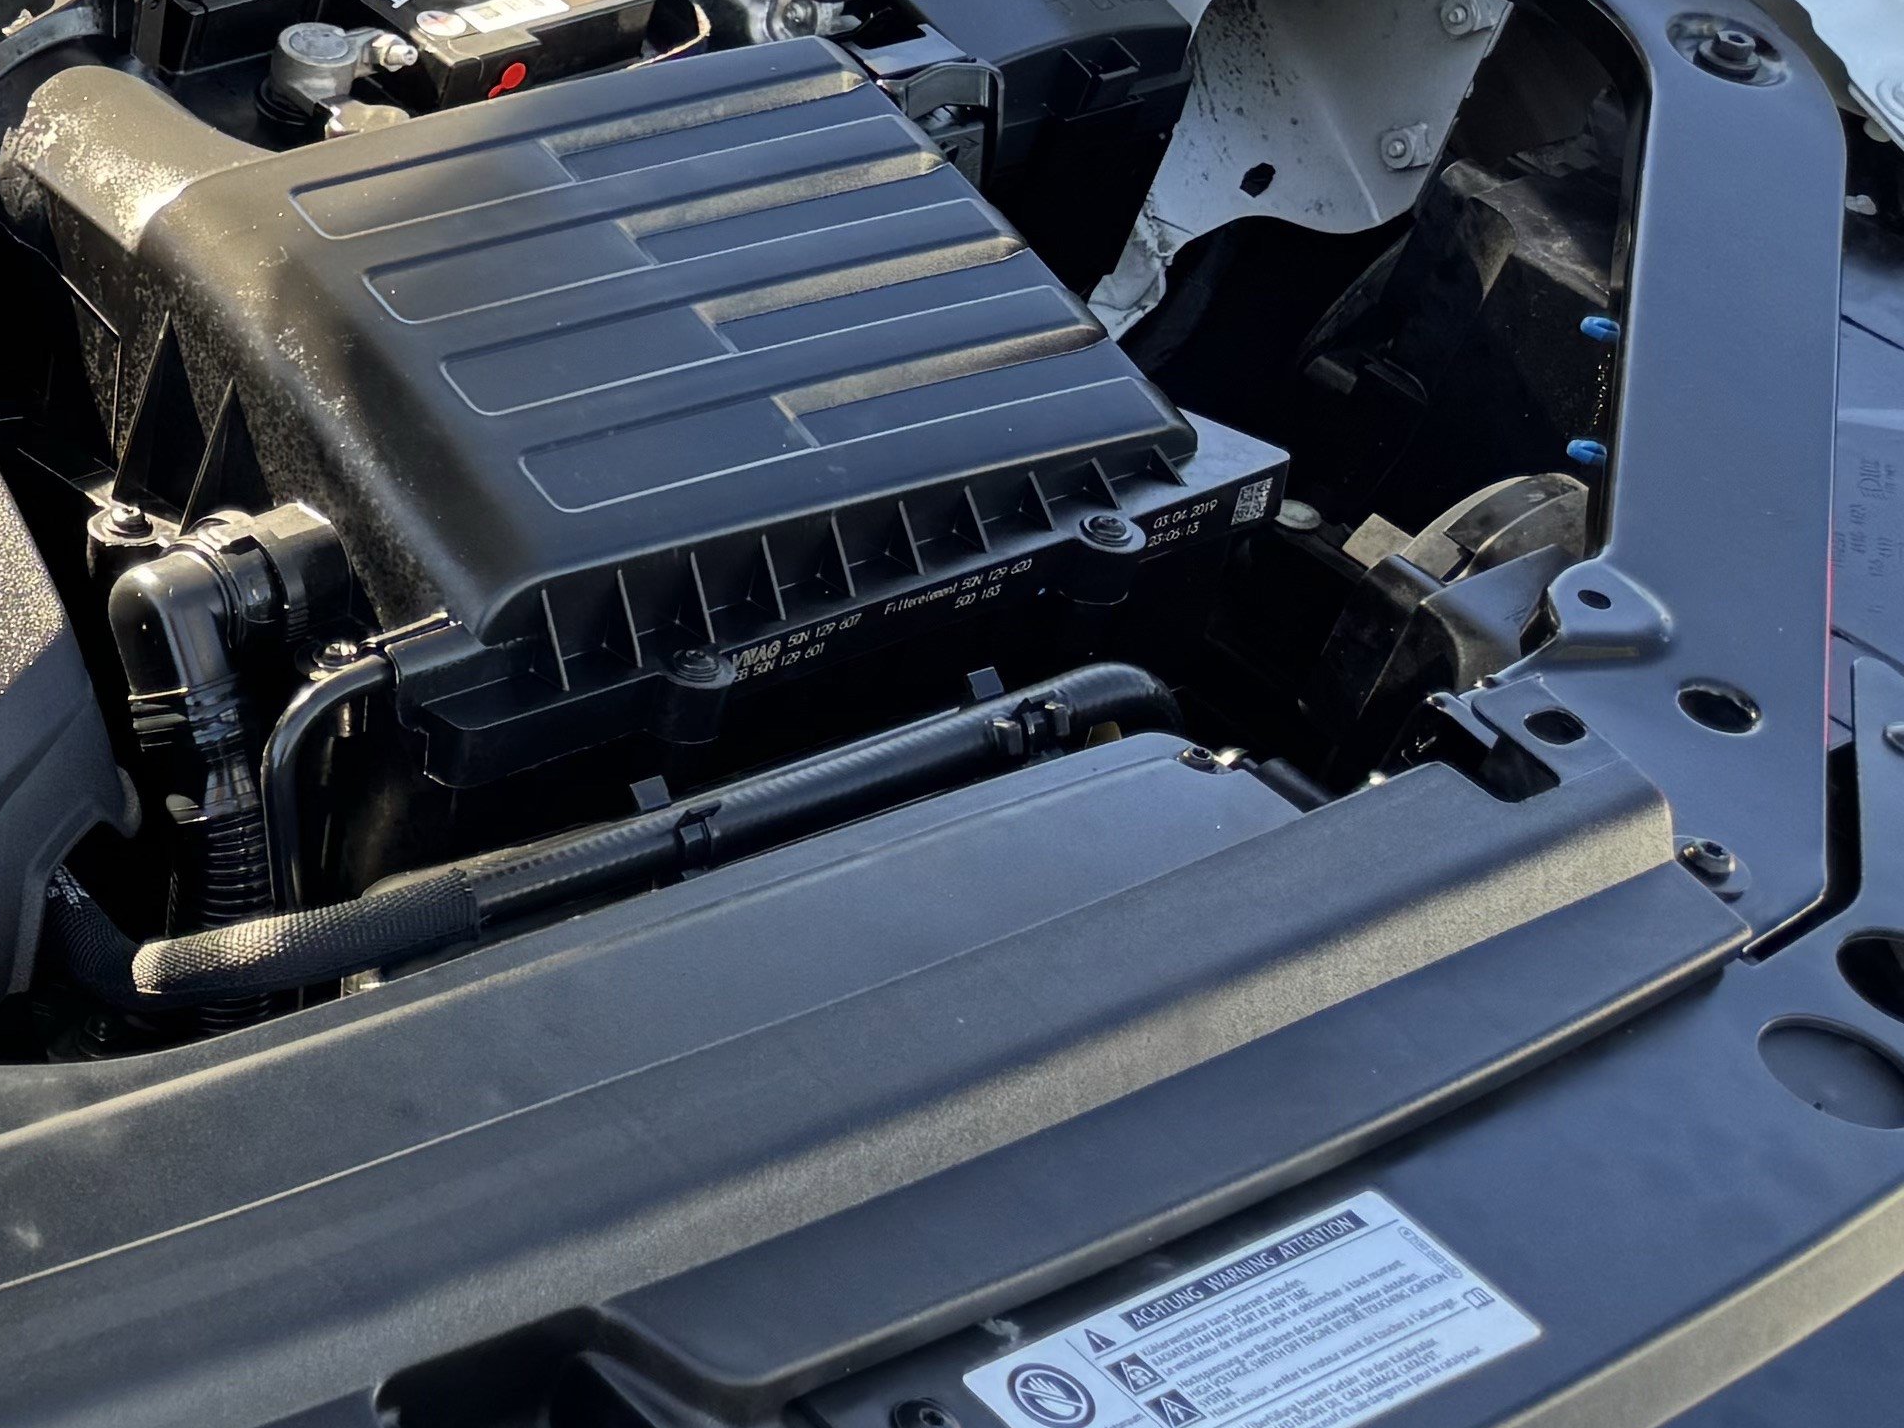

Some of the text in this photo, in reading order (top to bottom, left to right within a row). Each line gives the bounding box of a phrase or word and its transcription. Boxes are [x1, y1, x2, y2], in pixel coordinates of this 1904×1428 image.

[1131, 1285, 1204, 1326] ACHTUNG
[1203, 1252, 1277, 1291] WARNING
[1278, 1216, 1355, 1259] ATTENTION
[1230, 1311, 1260, 1329] START
[1256, 1305, 1271, 1317] AT
